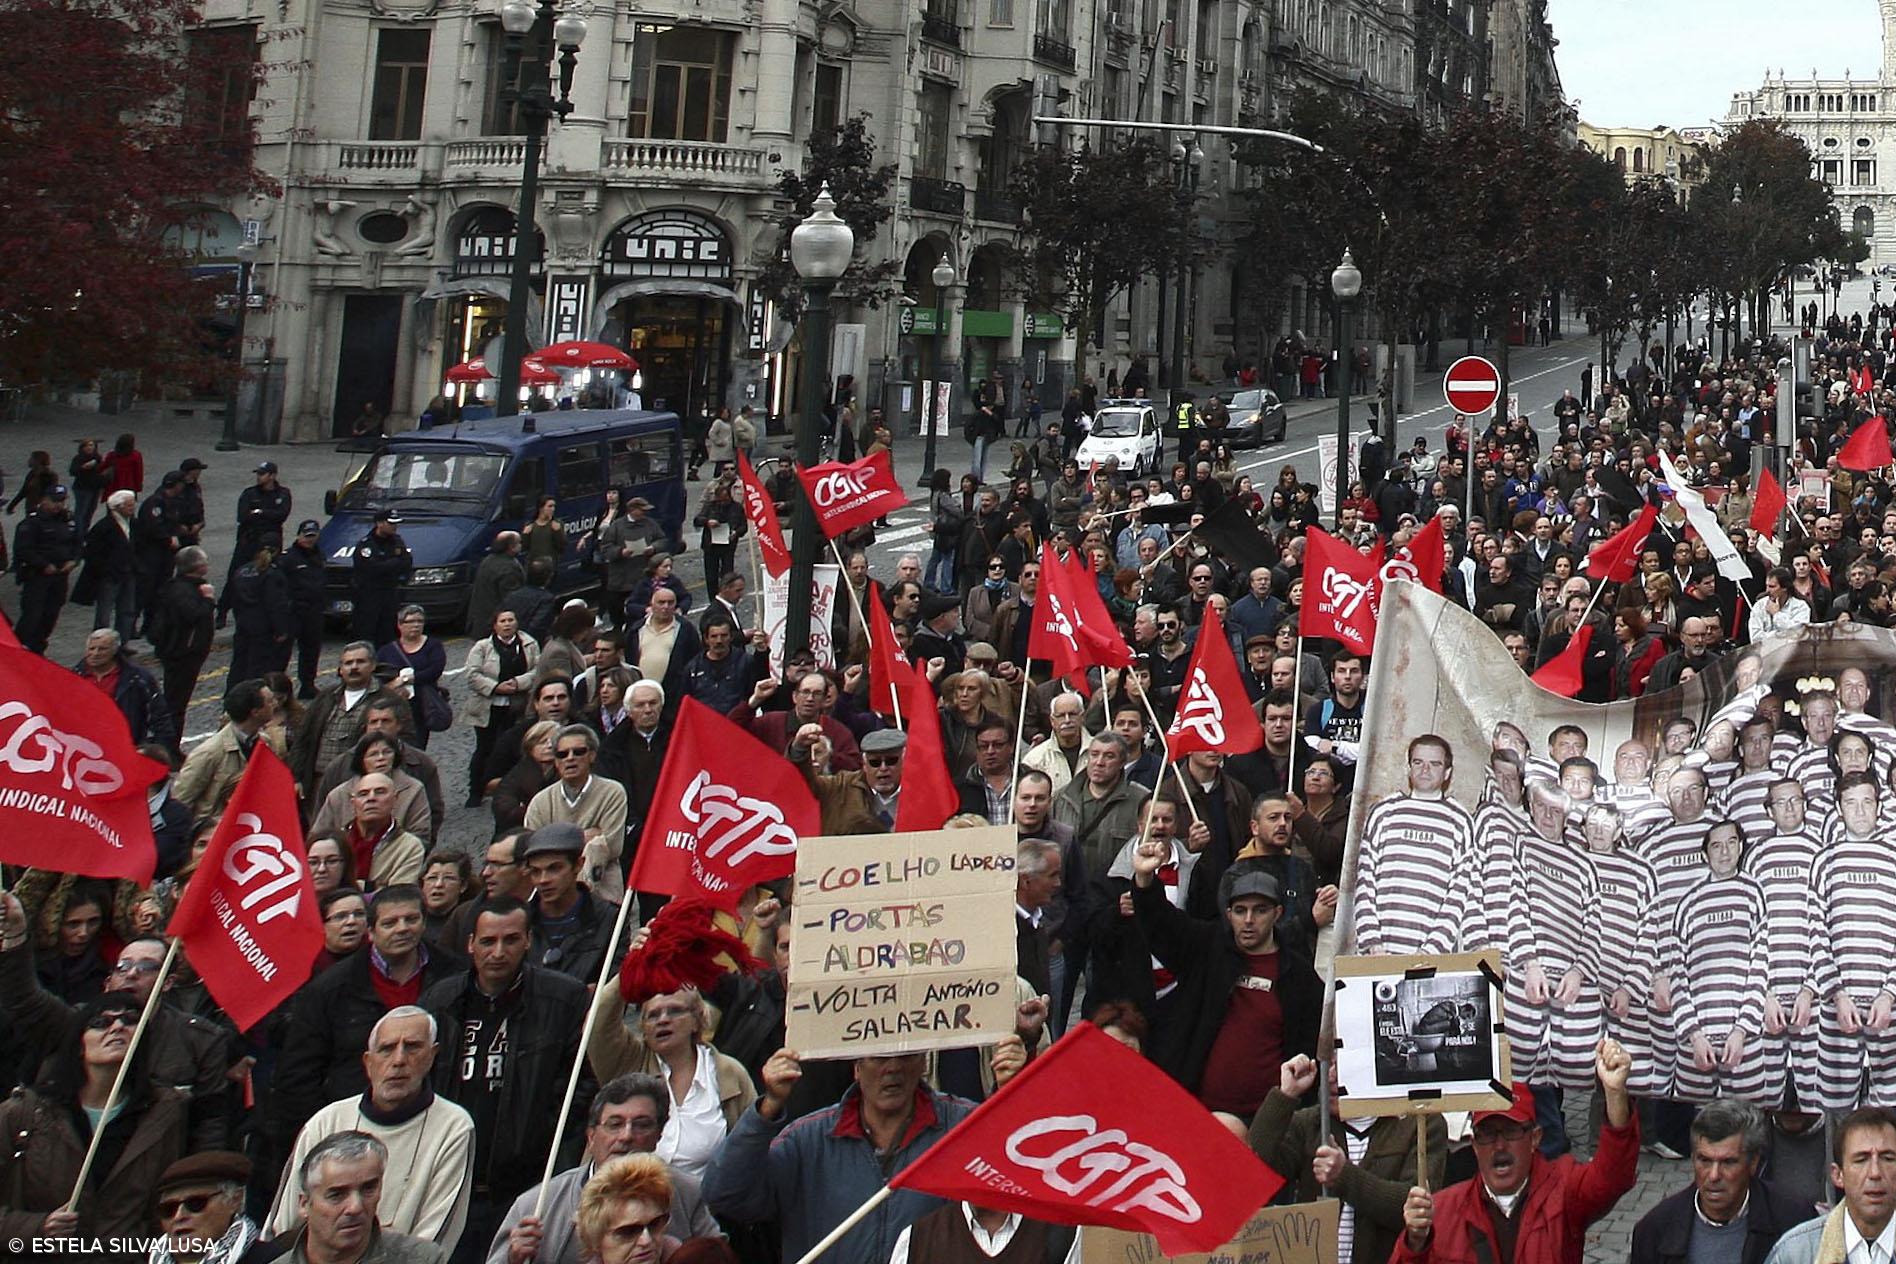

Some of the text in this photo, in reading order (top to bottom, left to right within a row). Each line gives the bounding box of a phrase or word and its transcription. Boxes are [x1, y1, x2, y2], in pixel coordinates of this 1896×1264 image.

[814, 466, 876, 507] CGTP
[0, 789, 124, 848] INDICAL NACIONAL
[680, 769, 798, 867] CGTP
[229, 922, 279, 982] NACIONAL
[1005, 1114, 1202, 1224] CGTP
